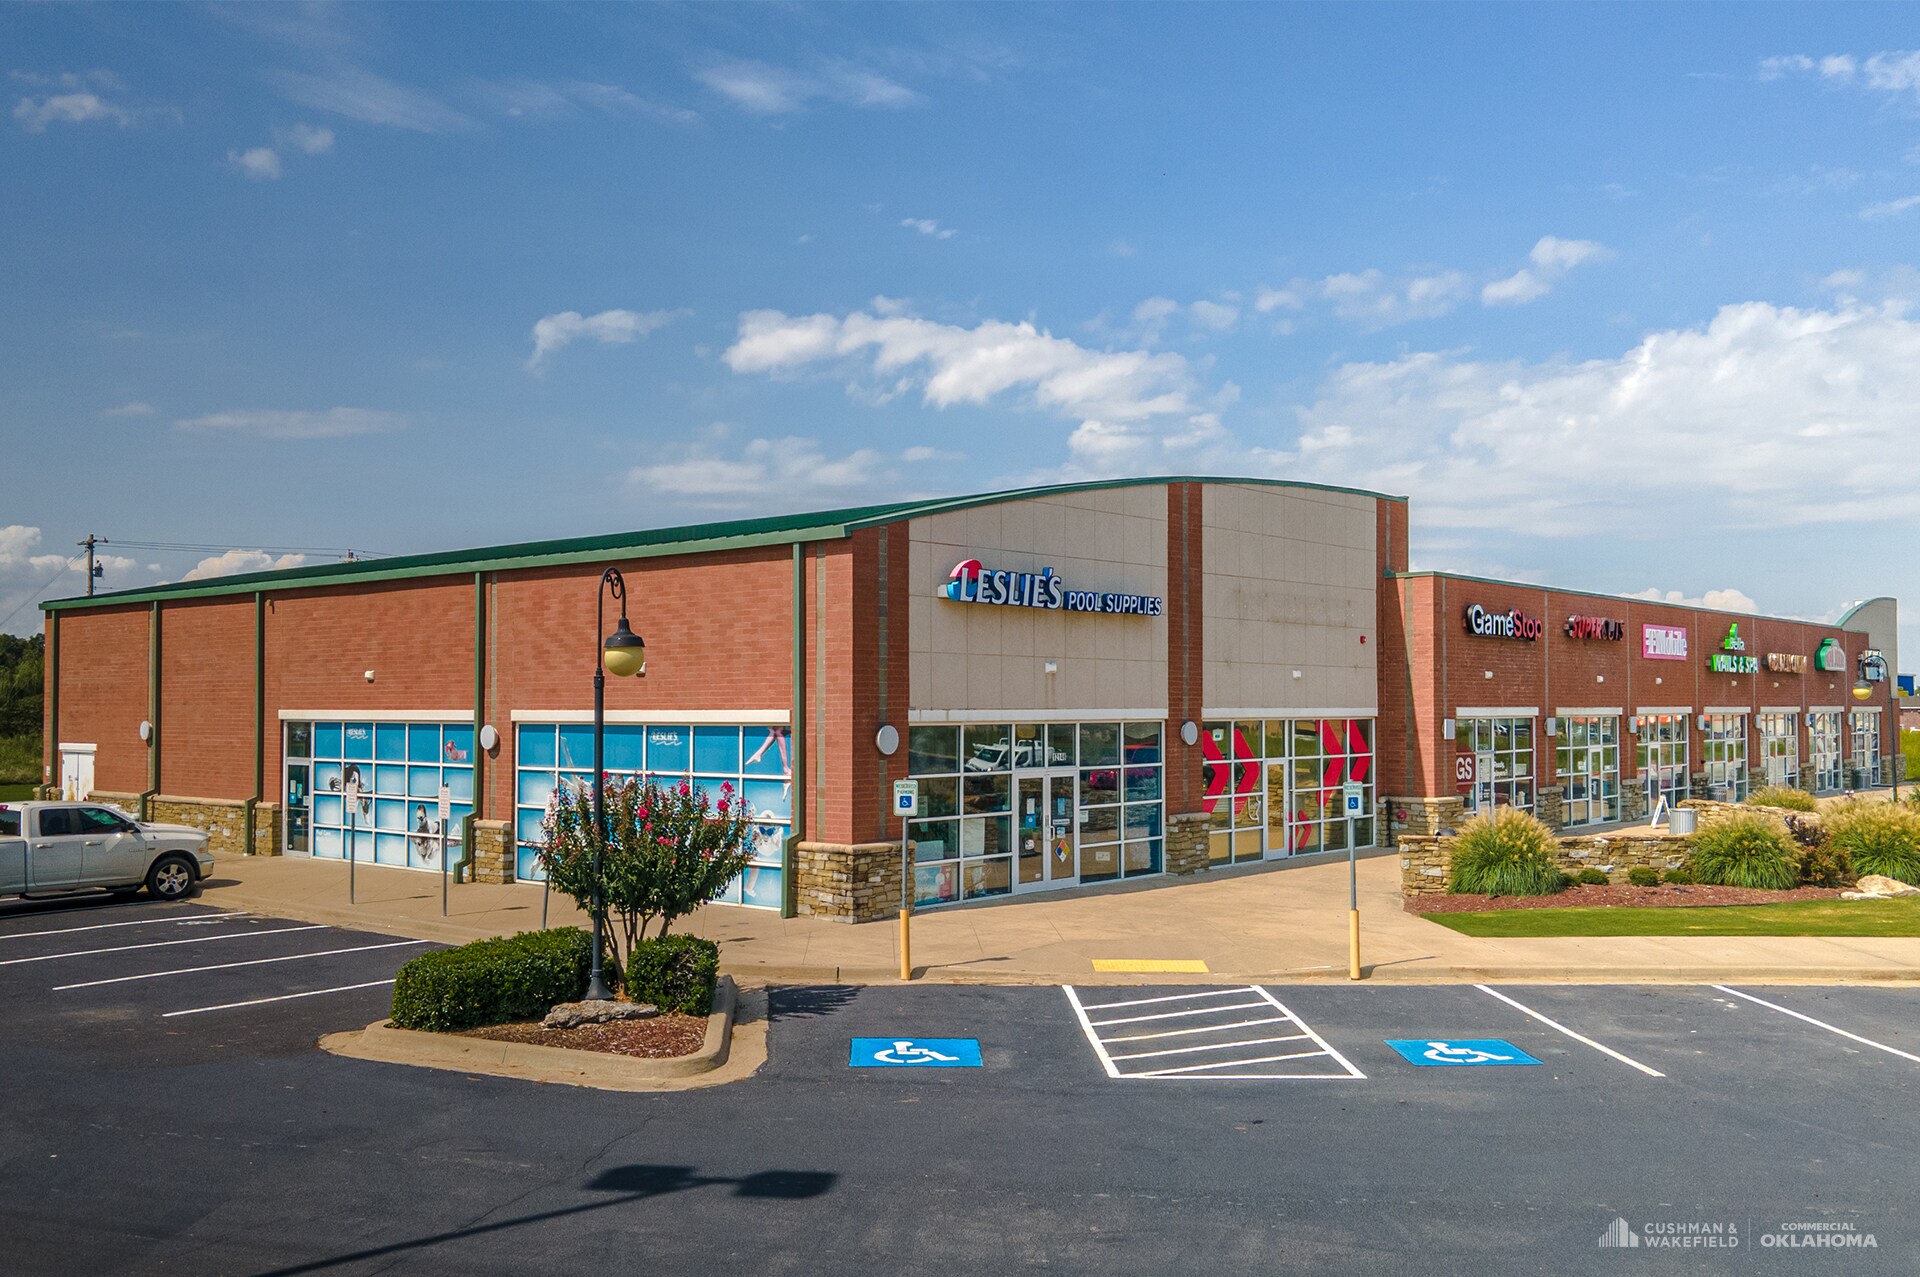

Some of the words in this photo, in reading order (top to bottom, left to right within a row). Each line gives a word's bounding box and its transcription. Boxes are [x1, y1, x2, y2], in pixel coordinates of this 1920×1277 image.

[960, 567, 1062, 609] LESLIE'S
[1068, 591, 1101, 611] POOL
[1105, 594, 1162, 616] SUPPLIES
[1471, 604, 1542, 641] GameStop
[1714, 654, 1737, 673] NAILS
[1738, 656, 1744, 673] &
[1746, 656, 1759, 673] SPA
[1456, 757, 1472, 780] GS
